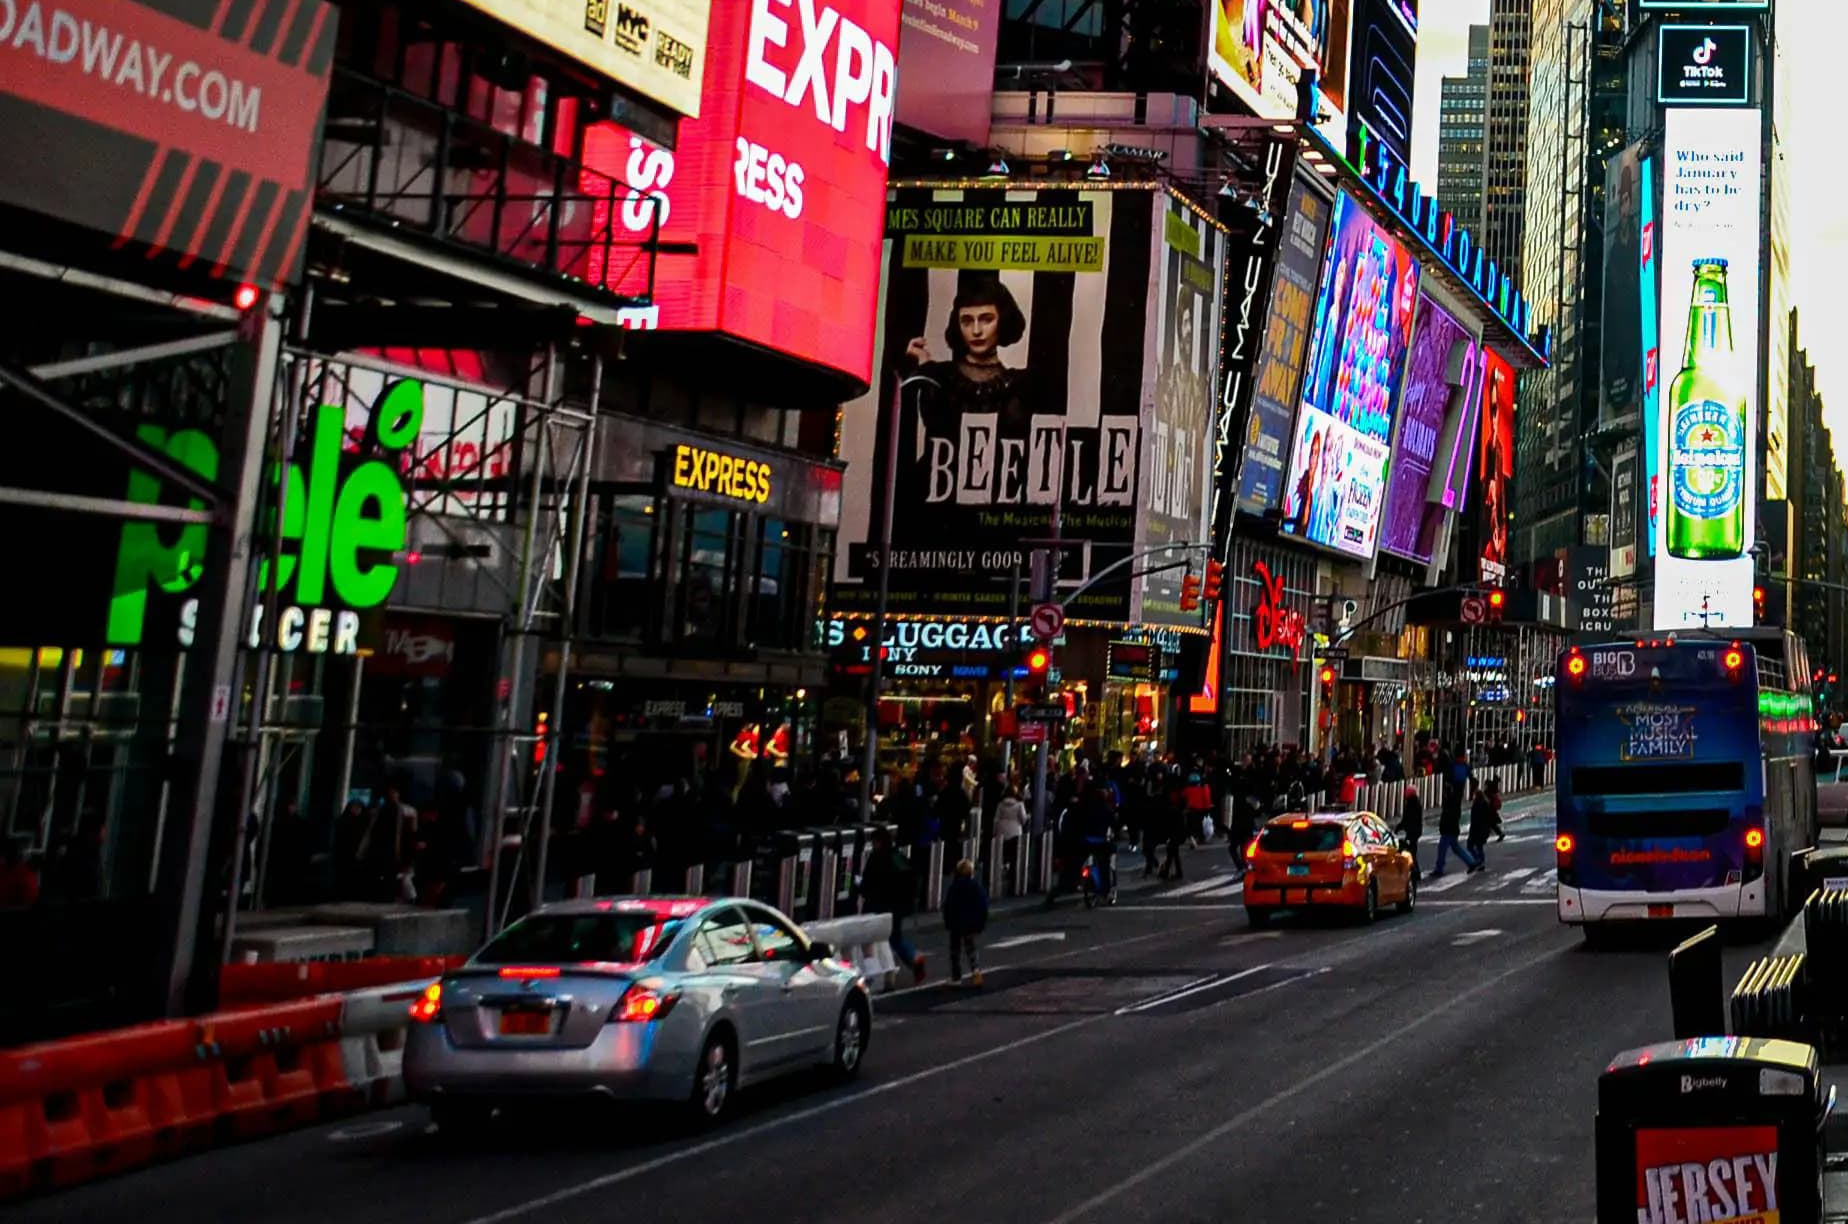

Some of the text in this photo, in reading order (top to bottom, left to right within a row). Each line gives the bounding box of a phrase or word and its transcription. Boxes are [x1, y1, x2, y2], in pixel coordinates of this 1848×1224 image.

[617, 2, 650, 43] NYC
[1683, 66, 1725, 78] TikTok
[1676, 150, 1745, 162] Who said
[1675, 167, 1737, 180] January
[1674, 199, 1711, 213] dry?
[923, 204, 1088, 232] SQUARE CAN REALLY
[910, 239, 1100, 266] MAKE YOU FEEL ALIVE!
[1231, 255, 1262, 361] MAC
[1214, 370, 1241, 477] MAC
[673, 444, 772, 505] EXPRESS
[1593, 651, 1617, 665] BIG
[895, 664, 942, 676] SONY
[1635, 713, 1679, 727] MOST
[1630, 724, 1699, 742] MUSICAL
[1629, 739, 1687, 756] FAMILY
[1637, 1152, 1778, 1224] JERSEY
